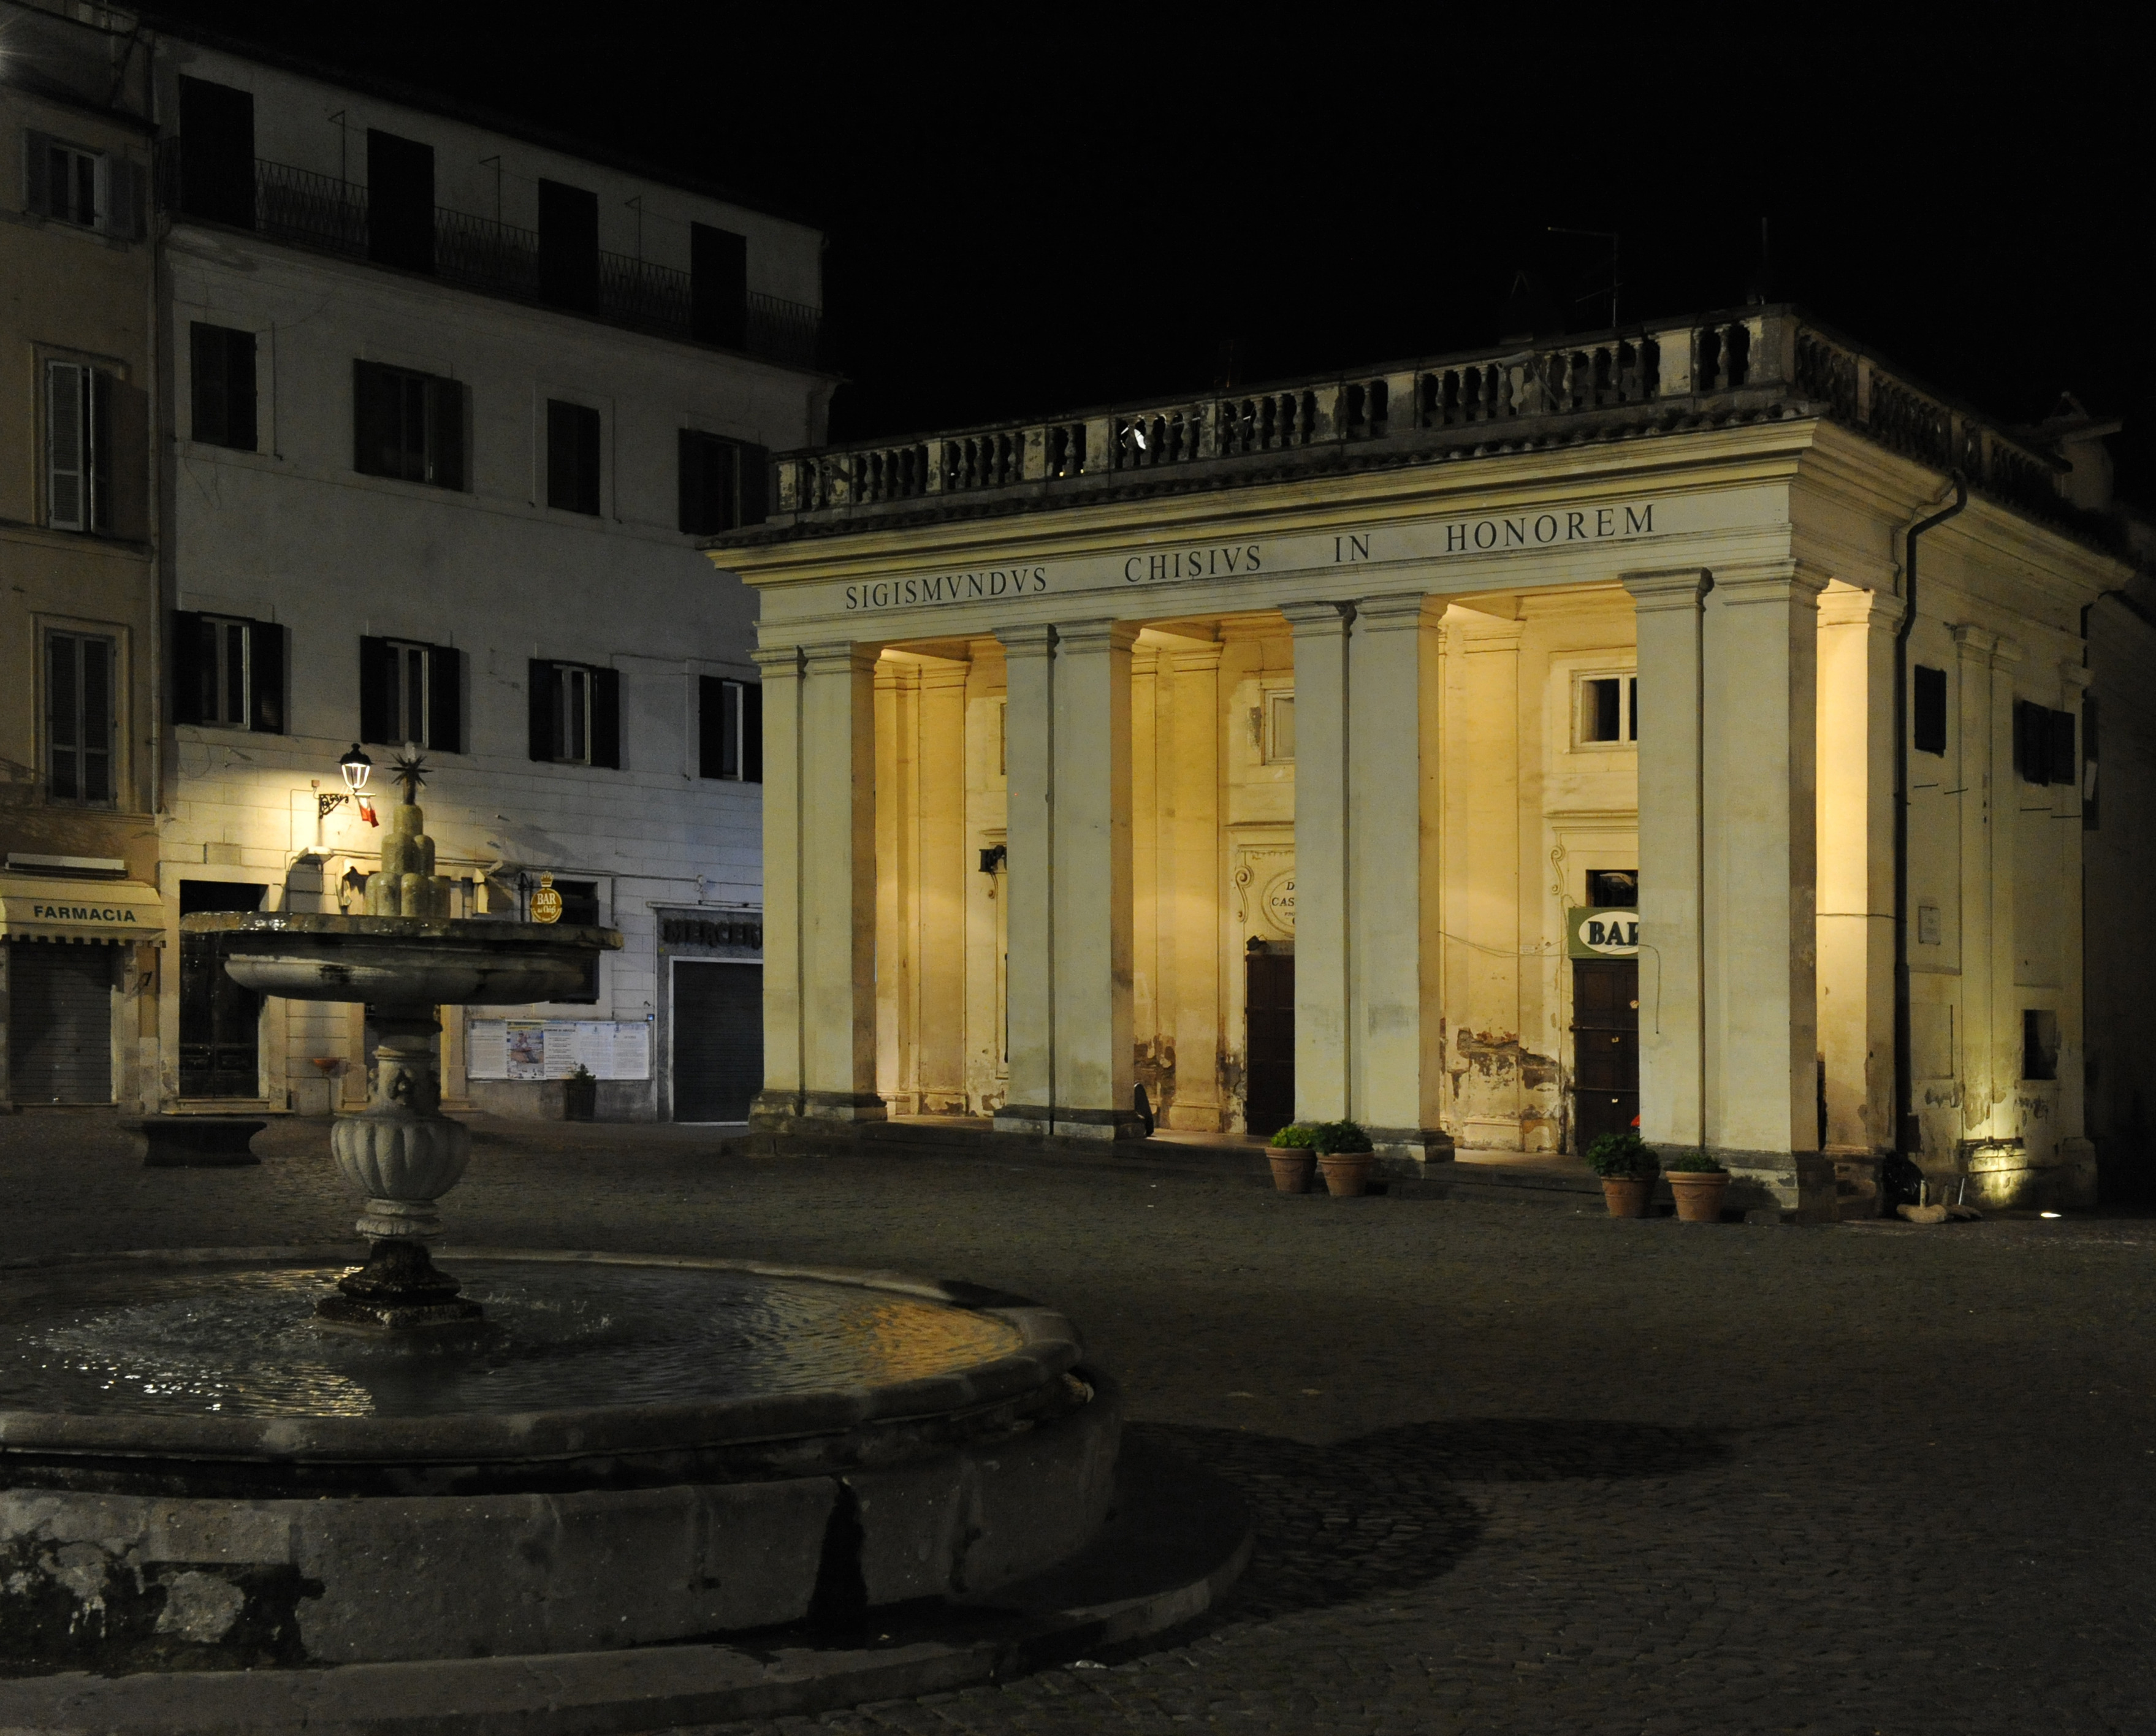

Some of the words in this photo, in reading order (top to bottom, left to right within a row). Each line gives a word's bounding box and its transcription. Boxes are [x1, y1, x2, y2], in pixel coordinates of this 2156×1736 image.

[845, 566, 1047, 610] SIGISMVNDVS
[1124, 545, 1262, 583] CHISIVS
[1333, 533, 1371, 563] IN
[1445, 504, 1655, 552] HONOREM
[537, 893, 557, 905] BAR
[34, 905, 136, 922] FARMACIA
